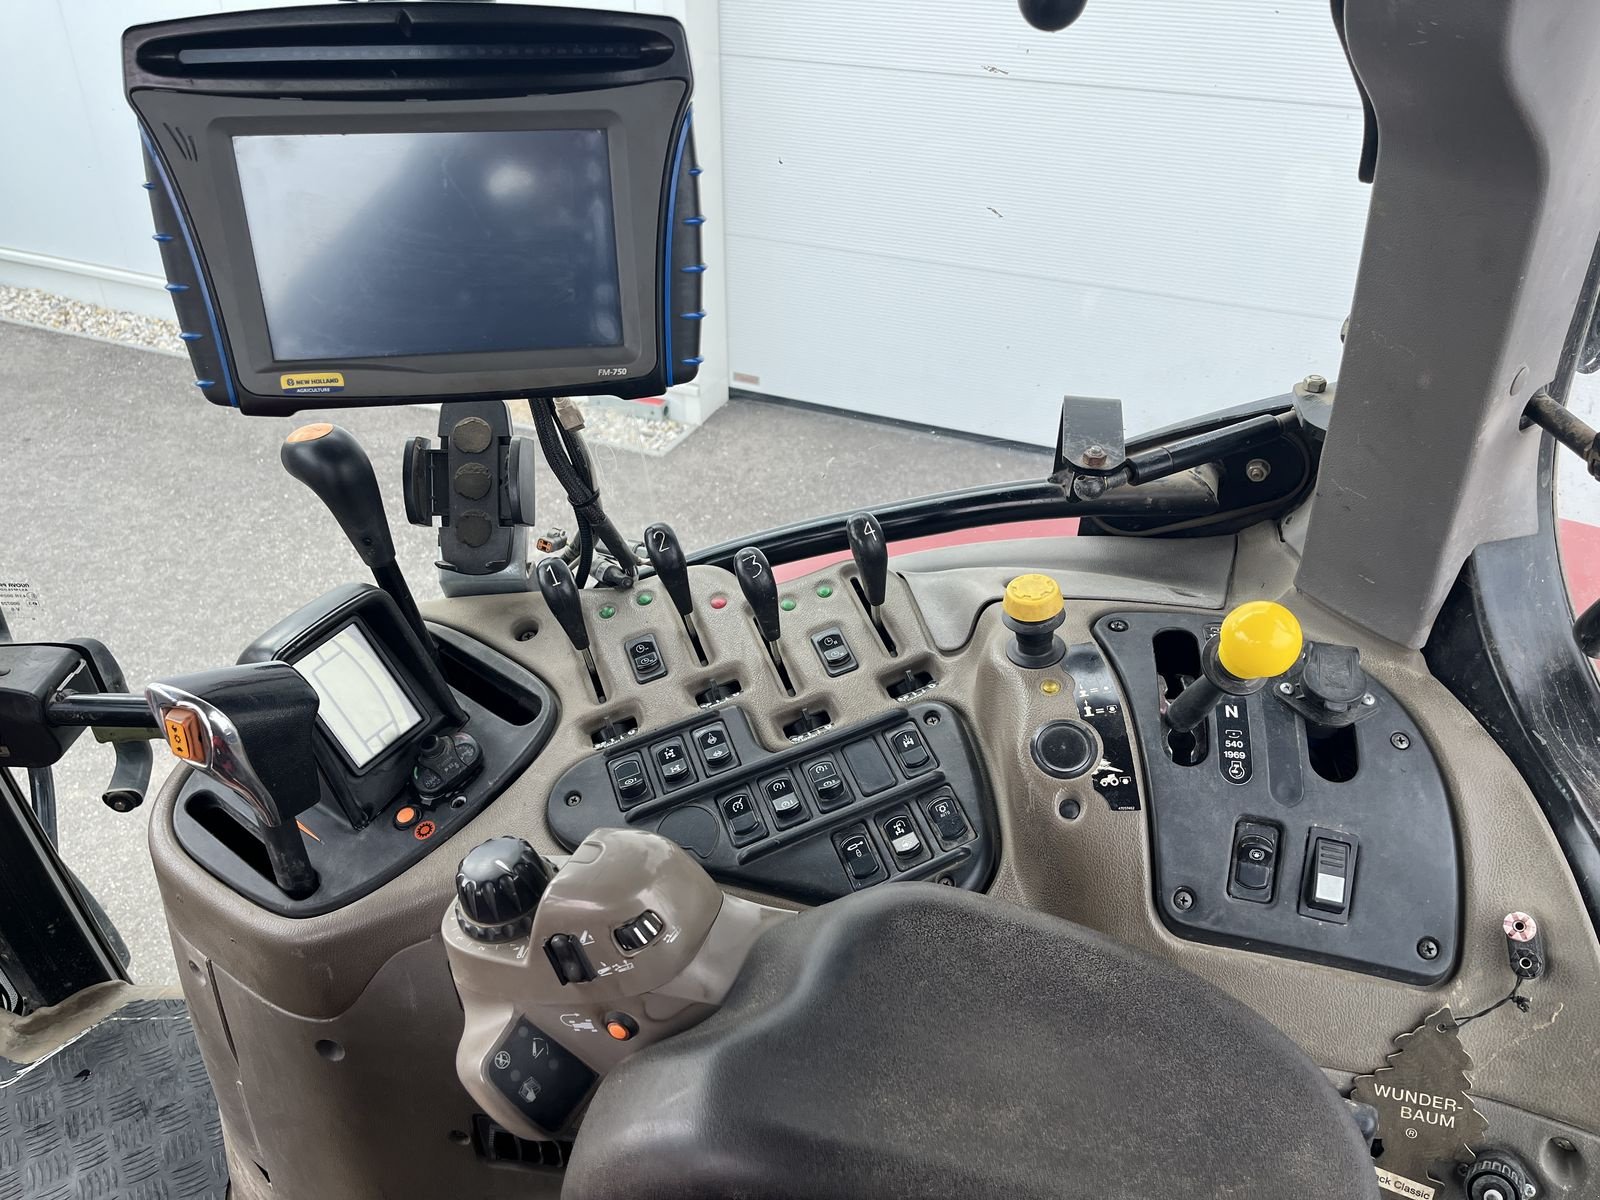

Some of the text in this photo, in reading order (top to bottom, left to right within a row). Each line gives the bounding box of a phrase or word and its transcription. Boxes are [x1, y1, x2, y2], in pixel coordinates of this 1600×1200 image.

[598, 368, 627, 376] FM-750
[863, 521, 876, 541] 4
[653, 531, 670, 552] 2
[546, 565, 561, 587] 1
[742, 554, 763, 578] 3
[1225, 704, 1239, 718] N
[1225, 740, 1244, 748] 540
[1223, 750, 1246, 759] 1969
[1374, 1083, 1463, 1112] WUNDER-
[1400, 1106, 1455, 1129] BAUM
[1393, 1180, 1430, 1200] Classic
